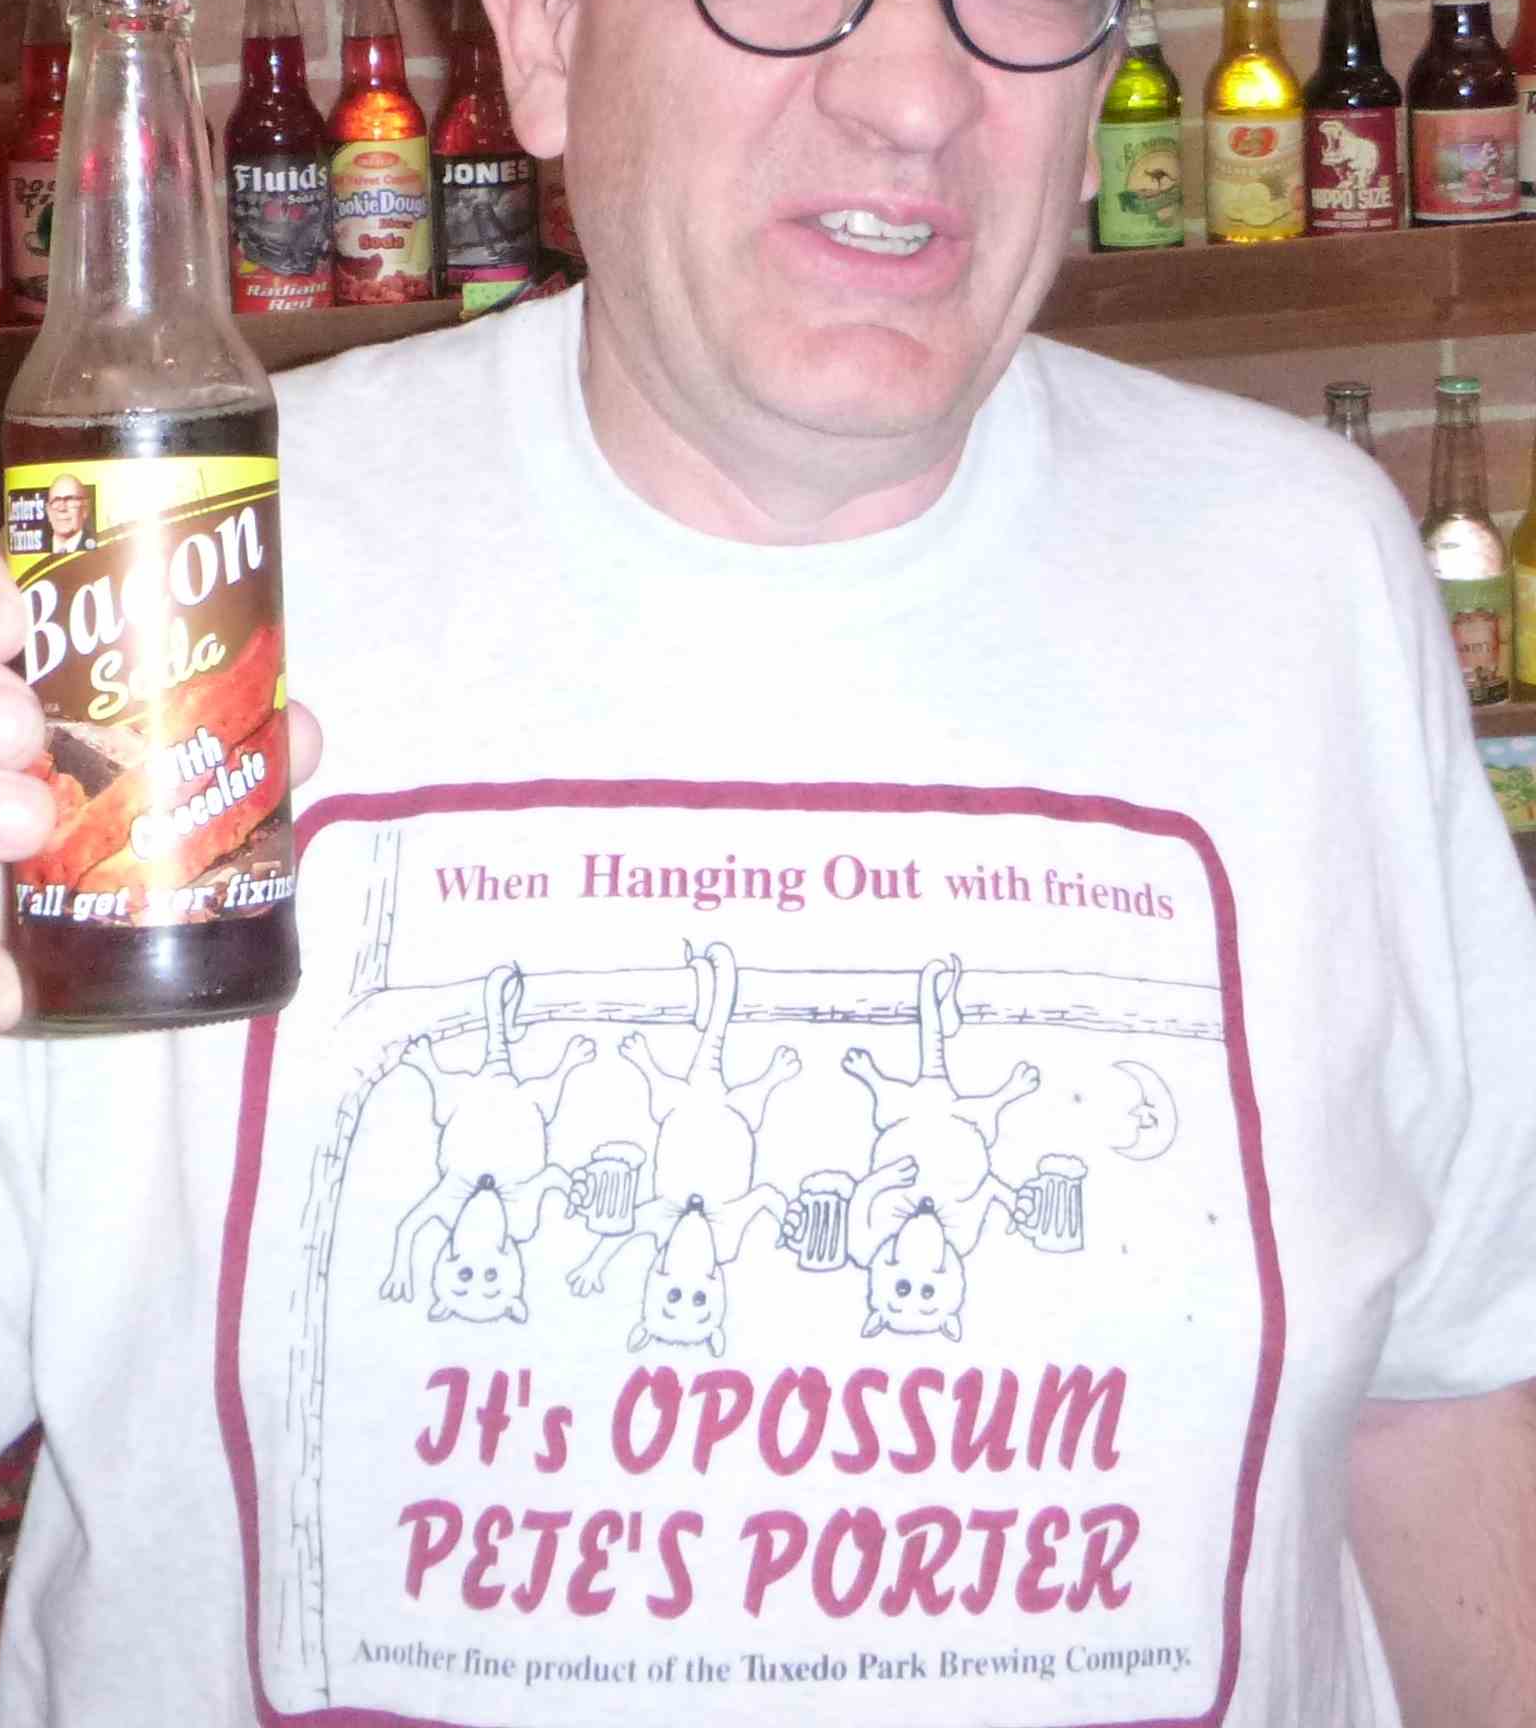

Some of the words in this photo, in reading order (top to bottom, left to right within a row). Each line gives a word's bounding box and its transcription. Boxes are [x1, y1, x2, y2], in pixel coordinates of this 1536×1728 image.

[233, 163, 327, 193] Fluids
[443, 161, 529, 184] JONES
[24, 503, 264, 686] Bacon
[72, 888, 131, 922] get
[434, 865, 550, 904] When
[579, 853, 807, 913] Hanging
[823, 853, 923, 901] Out
[944, 864, 1032, 903] with
[1043, 868, 1175, 921] friends
[414, 1366, 574, 1474] It's
[610, 1363, 1128, 1476] OPOSSUM
[398, 1499, 704, 1619] PETE'S
[739, 1502, 1141, 1619] PORTER
[353, 1638, 457, 1673] Another
[463, 1647, 516, 1679] fine
[524, 1654, 637, 1687] product
[647, 1655, 678, 1684] of
[684, 1655, 731, 1684] the
[740, 1653, 848, 1684] Tuxedo
[858, 1651, 927, 1681] Park
[939, 1647, 1056, 1681] Brewing
[1065, 1646, 1191, 1677] Company.
